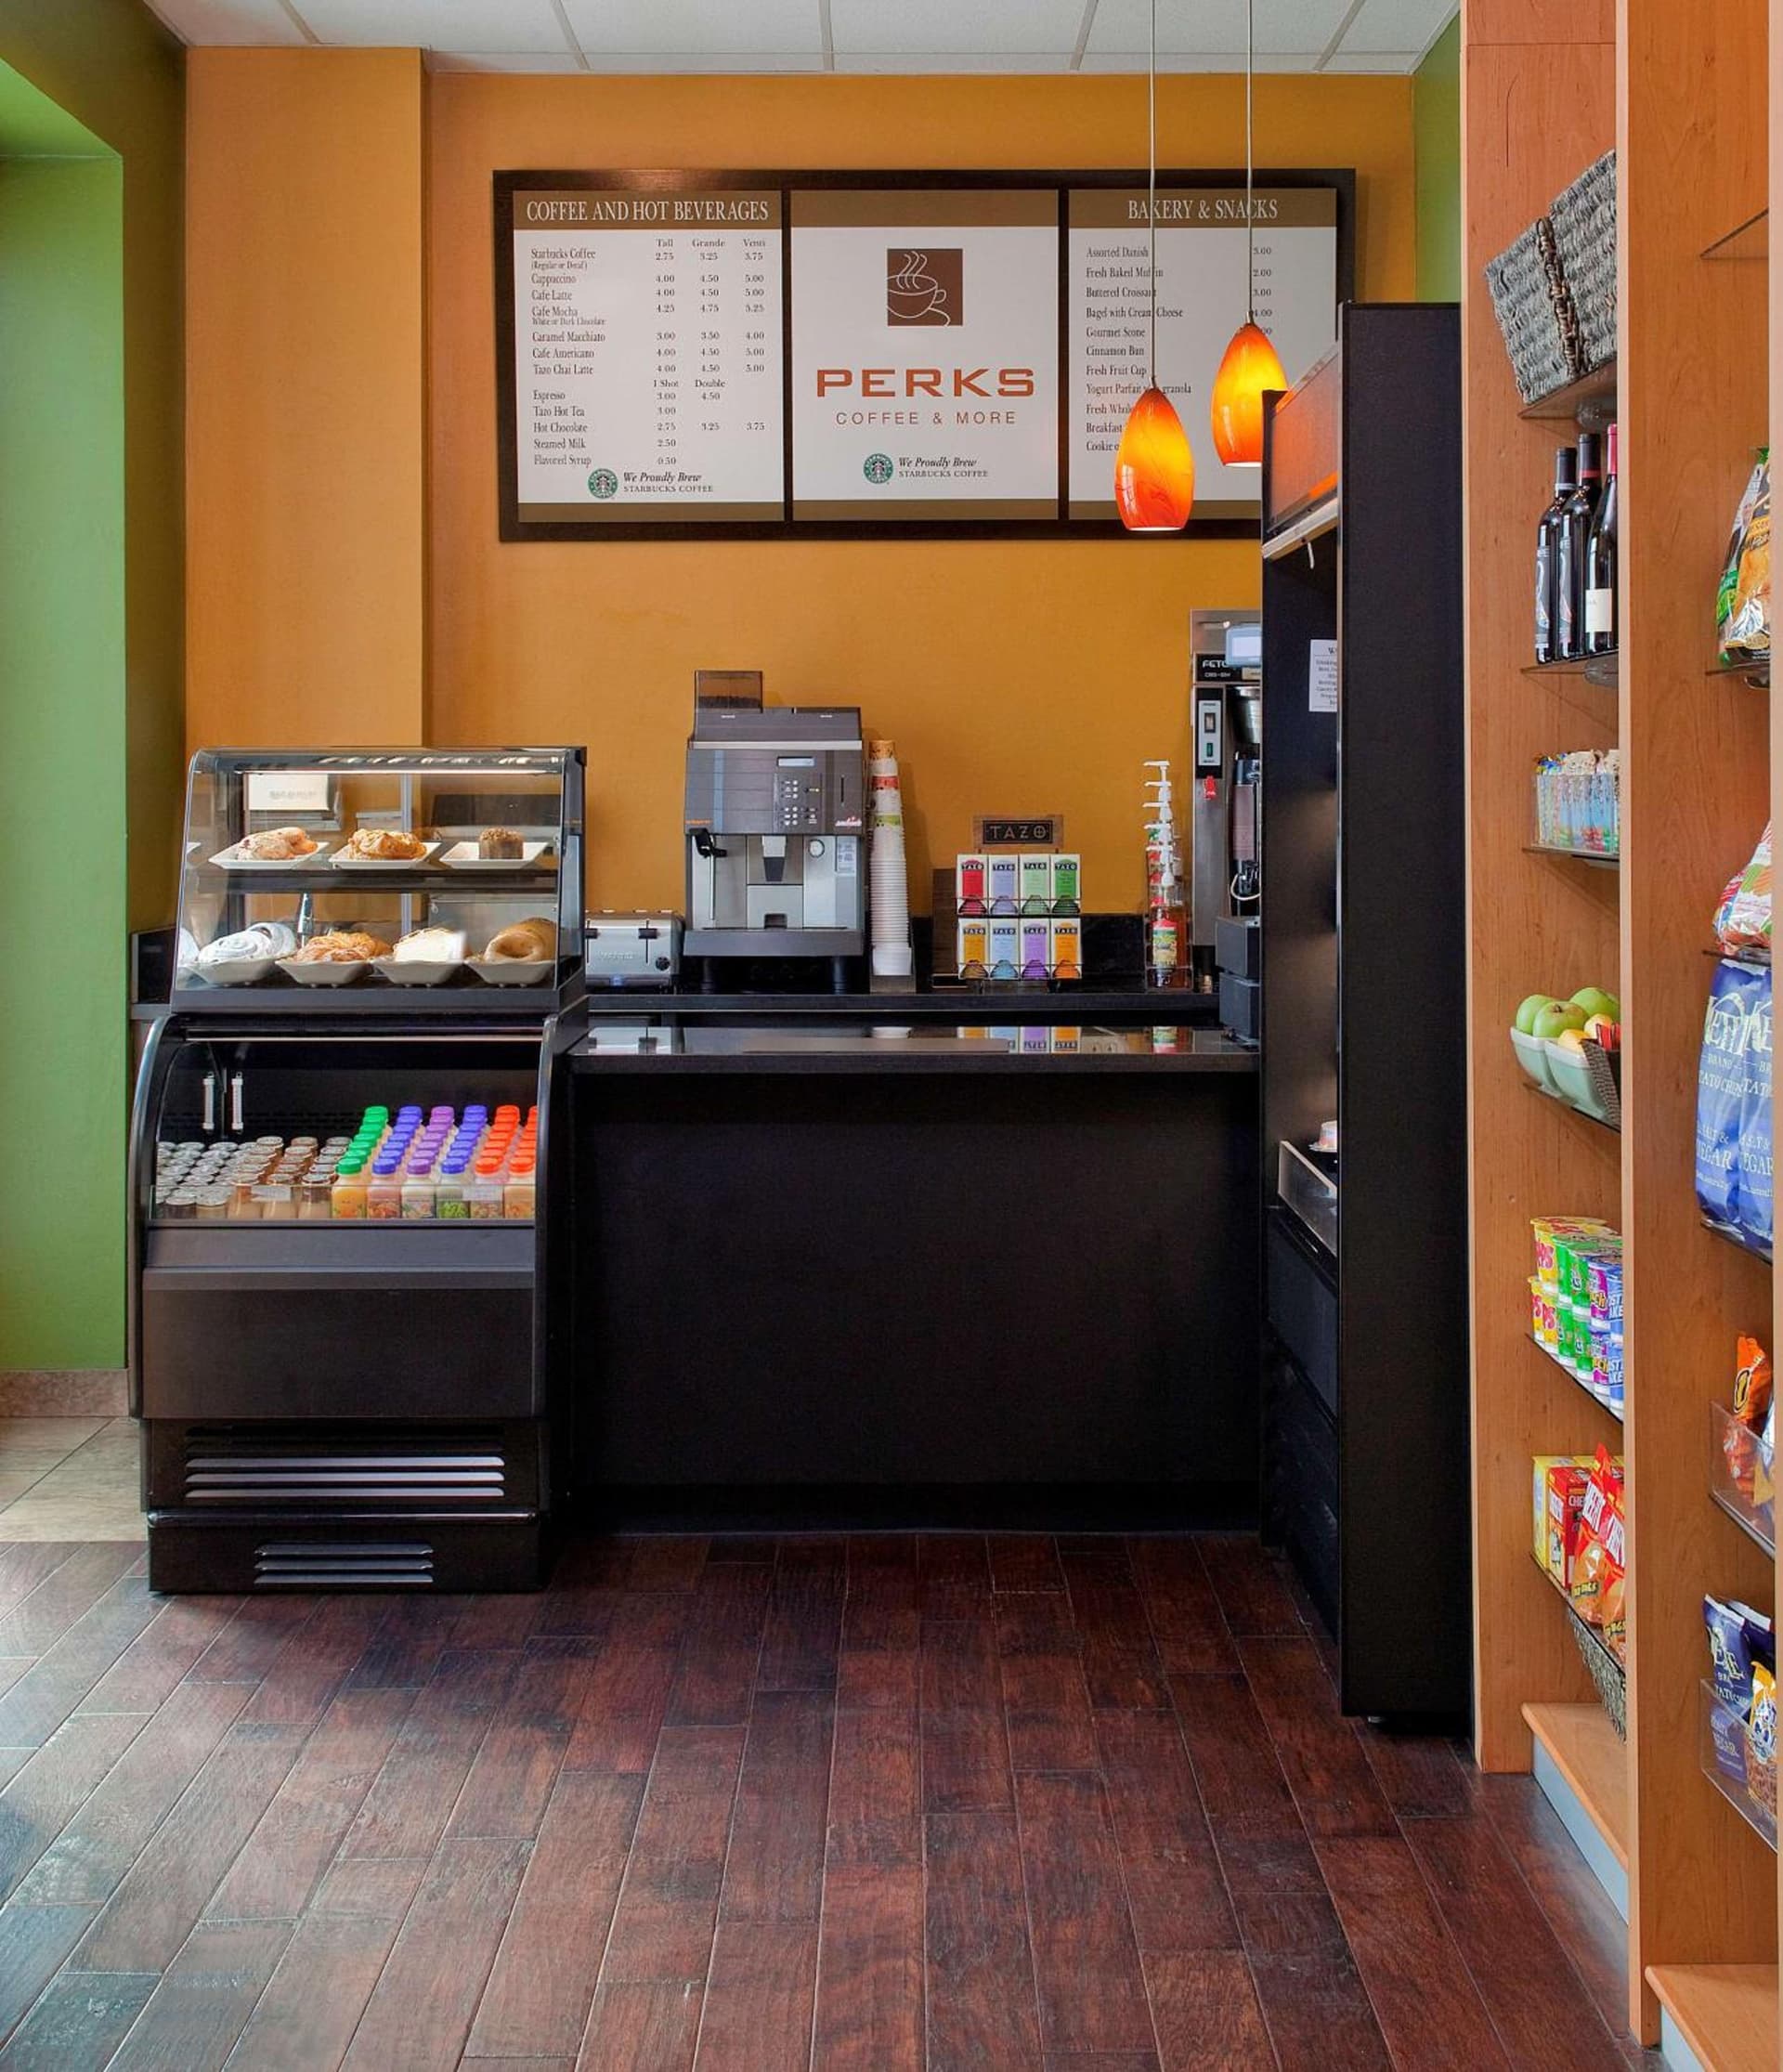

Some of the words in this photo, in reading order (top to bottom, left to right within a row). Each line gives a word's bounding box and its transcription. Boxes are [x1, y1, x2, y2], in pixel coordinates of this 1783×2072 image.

[527, 201, 587, 220] COFFEE
[592, 201, 628, 220] AND
[633, 201, 669, 220] HOT
[674, 201, 769, 220] BEVERAGES
[1128, 199, 1193, 220] BAKERY
[1198, 200, 1210, 220] &
[1215, 198, 1279, 219] SNACKS
[656, 239, 673, 248] Tall
[692, 239, 726, 248] Grande
[743, 238, 766, 247] Venti
[530, 247, 568, 259] Starbucks
[569, 247, 596, 259] Coffee
[655, 252, 674, 261] 2.75
[1087, 246, 1120, 258] Assorted
[1122, 246, 1149, 258] Danish
[1086, 266, 1108, 278] Fresh
[1109, 266, 1134, 278] Baked
[1136, 266, 1164, 278] Mufin
[530, 272, 577, 287] Cappuccino
[655, 274, 675, 283] 4.00
[745, 274, 764, 283] 5.00
[531, 289, 551, 301] Cafe
[552, 289, 572, 301] Latte
[655, 288, 675, 297] 4.00
[745, 288, 764, 297] 5.00
[1086, 286, 1120, 298] Buttered
[531, 306, 551, 318] Cafe
[552, 306, 579, 318] Mocha
[700, 304, 719, 313] 4.75
[1086, 306, 1108, 320] Bagel
[1109, 306, 1126, 318] with
[1156, 306, 1184, 318] Cheese
[532, 331, 566, 343] Caramel
[567, 331, 606, 343] Macchiato
[1086, 326, 1122, 338] Gourmet
[1124, 326, 1146, 338] Scone
[532, 347, 552, 359] Cafe
[553, 347, 595, 359] Americano
[656, 347, 676, 358] 4.00
[1086, 345, 1126, 357] Cinnamon
[1128, 345, 1145, 357] Bun
[533, 363, 553, 375] Tazo
[553, 363, 572, 375] Chai
[574, 363, 594, 375] Latte
[746, 364, 765, 373] 5.00
[1086, 364, 1108, 376] Fresh
[1110, 363, 1128, 376] Fruit
[1130, 363, 1148, 379] Cup
[694, 378, 726, 388] Double
[816, 368, 1035, 397] PERKS
[1086, 382, 1113, 397] Yogurt
[532, 389, 566, 403] Espresso
[532, 405, 553, 417] Tazo
[553, 405, 570, 417] Hot
[570, 405, 586, 417] Tea
[1086, 402, 1108, 415] Fresh
[1109, 402, 1132, 415] Whol
[836, 411, 918, 425] COFFEE
[932, 411, 943, 425] &
[956, 410, 1016, 424] MORE
[533, 421, 549, 434] Hot
[550, 421, 588, 434] Chocolate
[1086, 422, 1123, 434] Breakfast
[533, 437, 566, 450] Steamed
[567, 437, 586, 450] Milk
[1086, 440, 1113, 452] Cookie
[568, 453, 592, 469] Syrup
[898, 456, 913, 467] We
[915, 456, 951, 470] Proudly
[953, 456, 978, 467] Brew
[623, 472, 638, 482] We
[640, 471, 676, 484] Proudly
[677, 472, 703, 482] Brew
[898, 470, 952, 478] STARBUCKS
[953, 470, 989, 478] COFFEE
[623, 485, 677, 493] STARBUCKS
[678, 485, 714, 493] COFFEE
[989, 825, 1048, 840] TAZO
